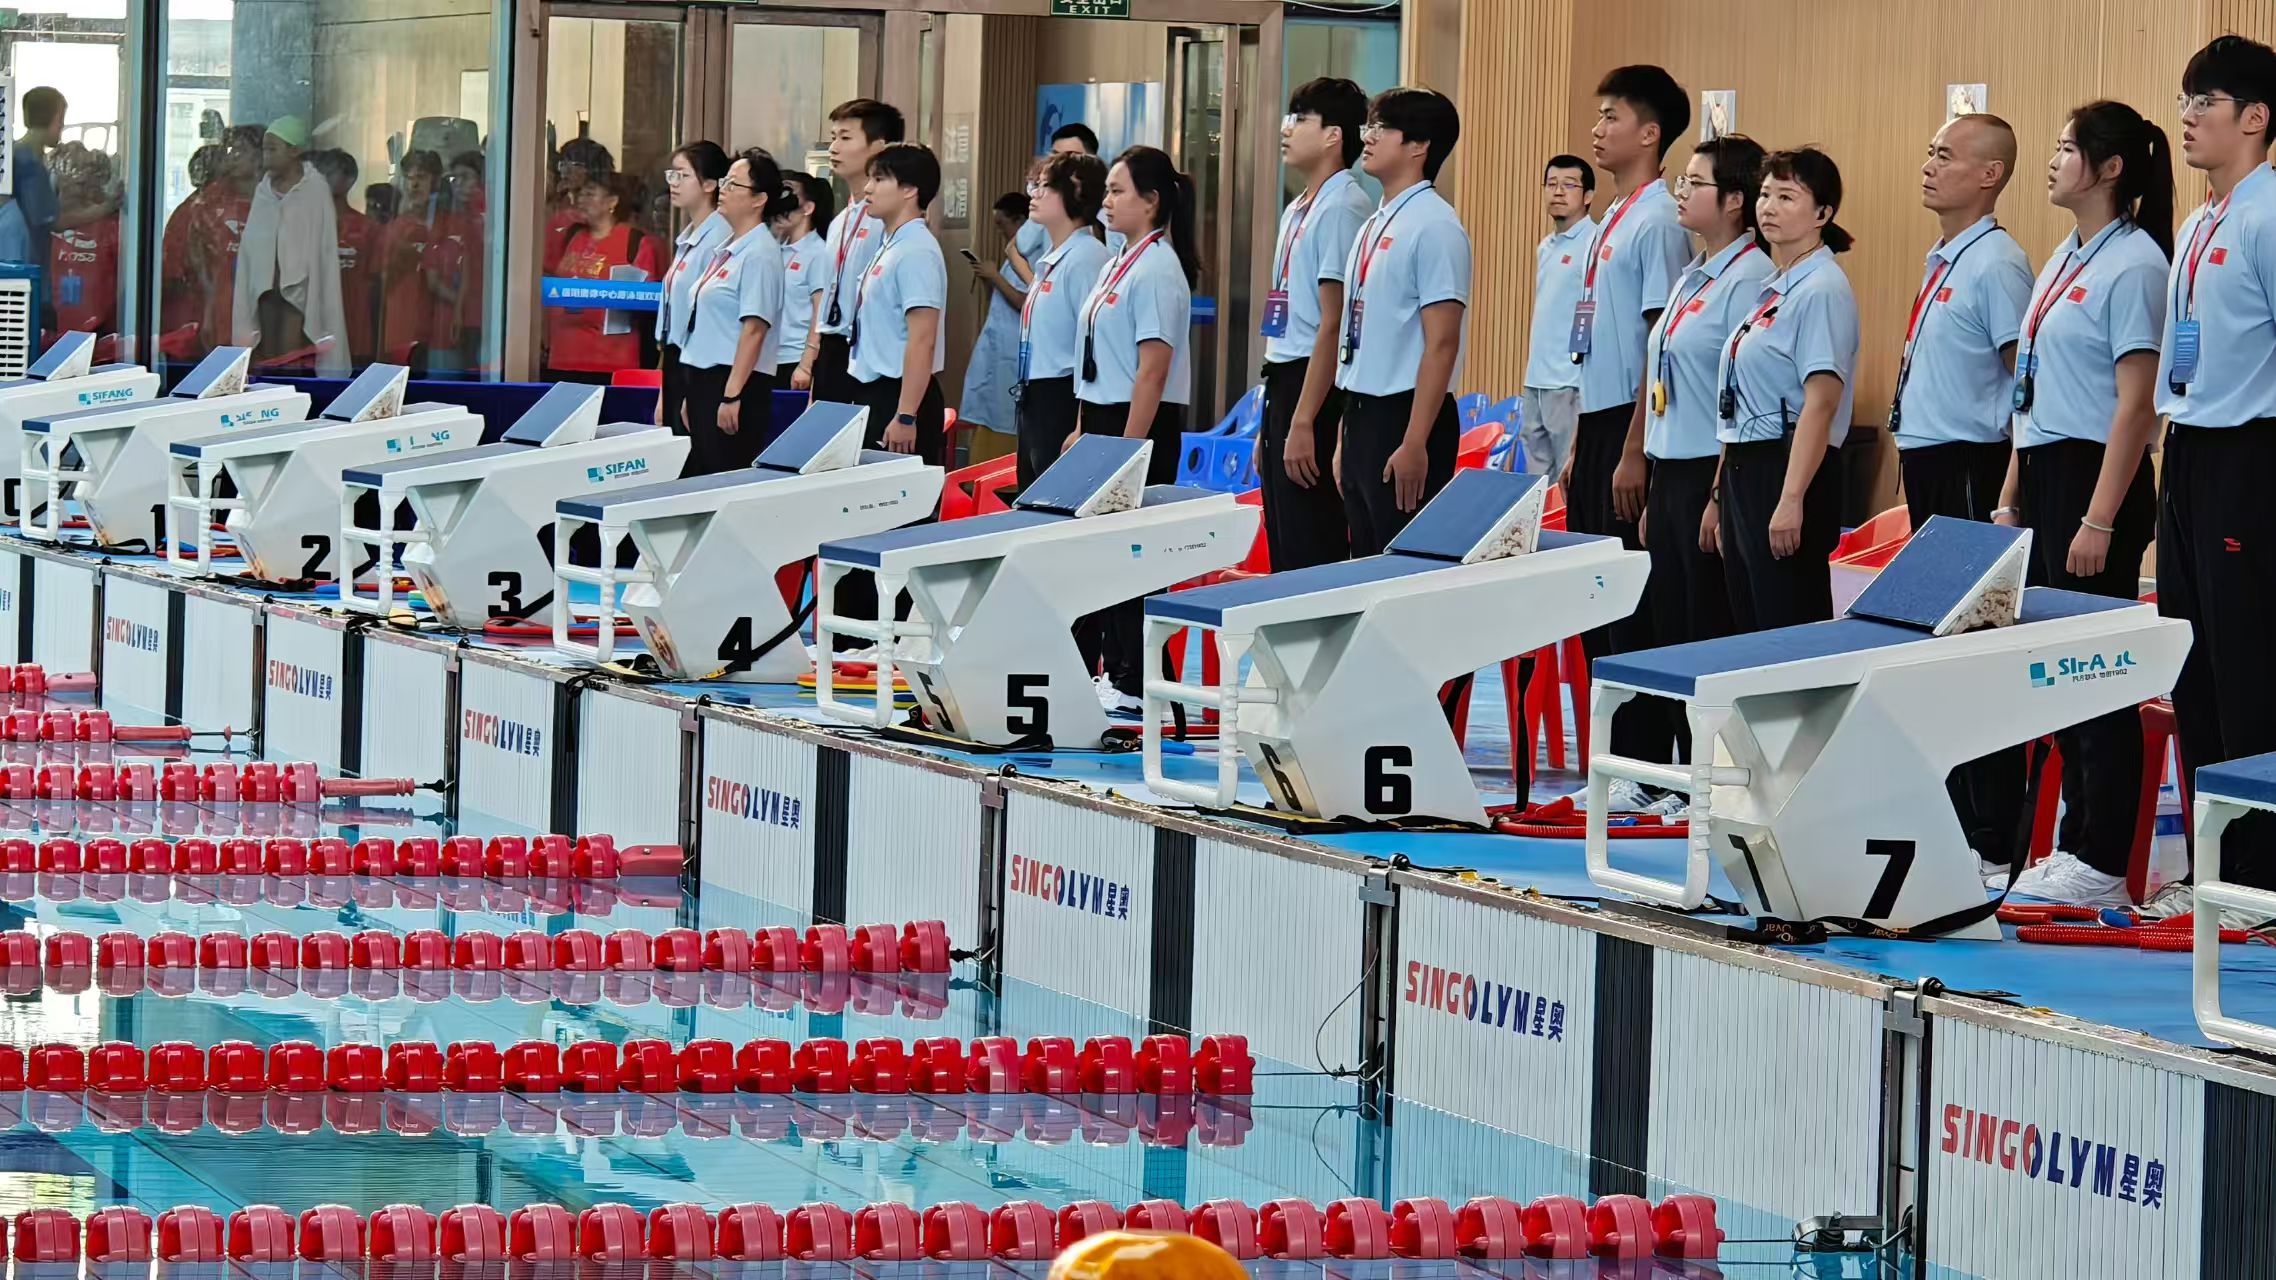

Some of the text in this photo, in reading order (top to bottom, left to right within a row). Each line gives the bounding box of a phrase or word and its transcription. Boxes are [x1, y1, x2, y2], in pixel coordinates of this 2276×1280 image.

[1069, 5, 1111, 15] EXIT
[92, 387, 133, 400] SIFANG
[301, 535, 332, 580] 2
[488, 571, 522, 620] 3
[717, 616, 752, 671] 4
[268, 659, 319, 698] SINGOLYM
[917, 671, 955, 733] 5
[1006, 673, 1050, 735] 5
[464, 709, 524, 754] SINGOLYM
[707, 775, 780, 825] SINGOLYM
[1364, 745, 1413, 815] 6
[1010, 854, 1130, 920] SINGOLYM 星奥
[1861, 838, 1916, 919] 7
[1405, 960, 1565, 1043] SINGOLYM 星奥
[1941, 1103, 2165, 1210] SINGOLYM 星奥
